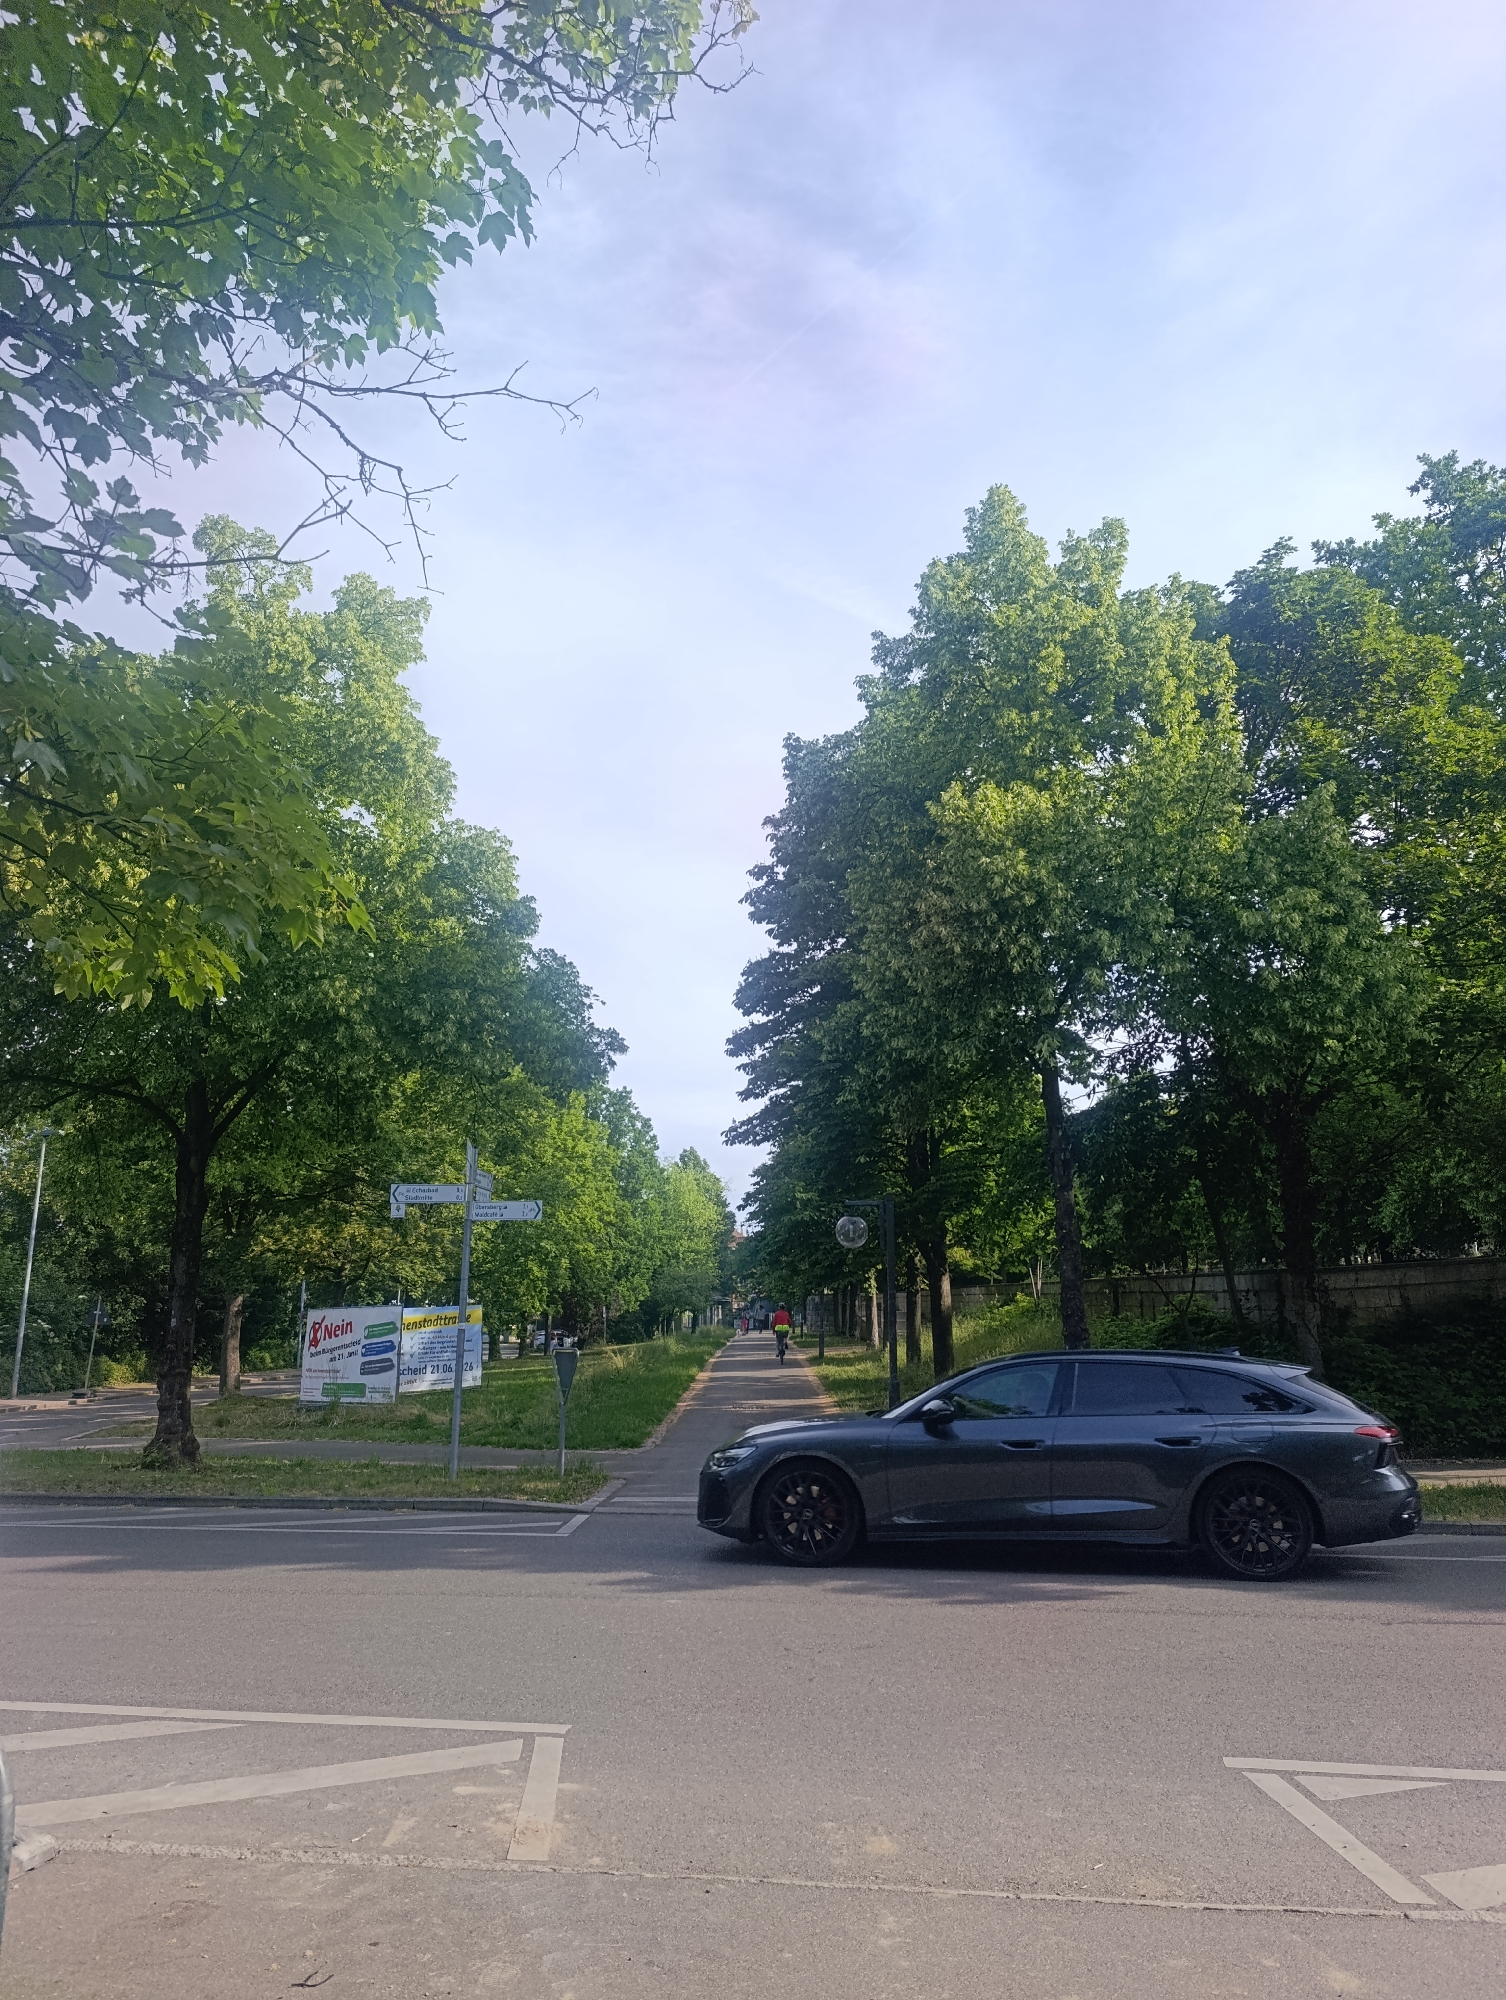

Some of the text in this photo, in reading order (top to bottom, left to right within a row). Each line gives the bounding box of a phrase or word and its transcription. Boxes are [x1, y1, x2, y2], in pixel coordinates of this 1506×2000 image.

[323, 1319, 353, 1341] Nein
[322, 1338, 362, 1355] Bürgerentscheid
[431, 1362, 474, 1375] 21.06.26
